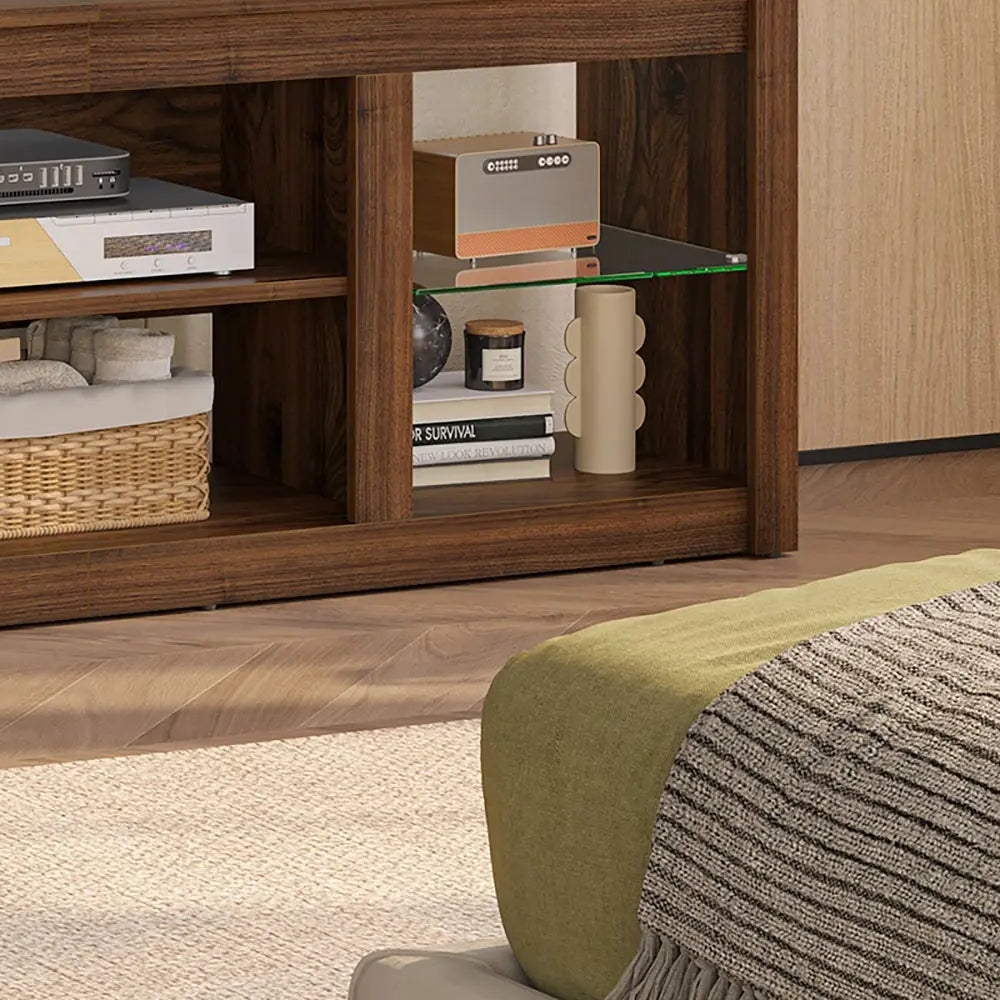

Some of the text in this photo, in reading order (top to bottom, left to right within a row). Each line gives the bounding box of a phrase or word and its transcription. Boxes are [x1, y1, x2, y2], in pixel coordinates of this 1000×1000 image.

[425, 424, 476, 441] SURVIVAL
[440, 449, 471, 460] LOOK
[473, 443, 546, 458] REVOLUTION
